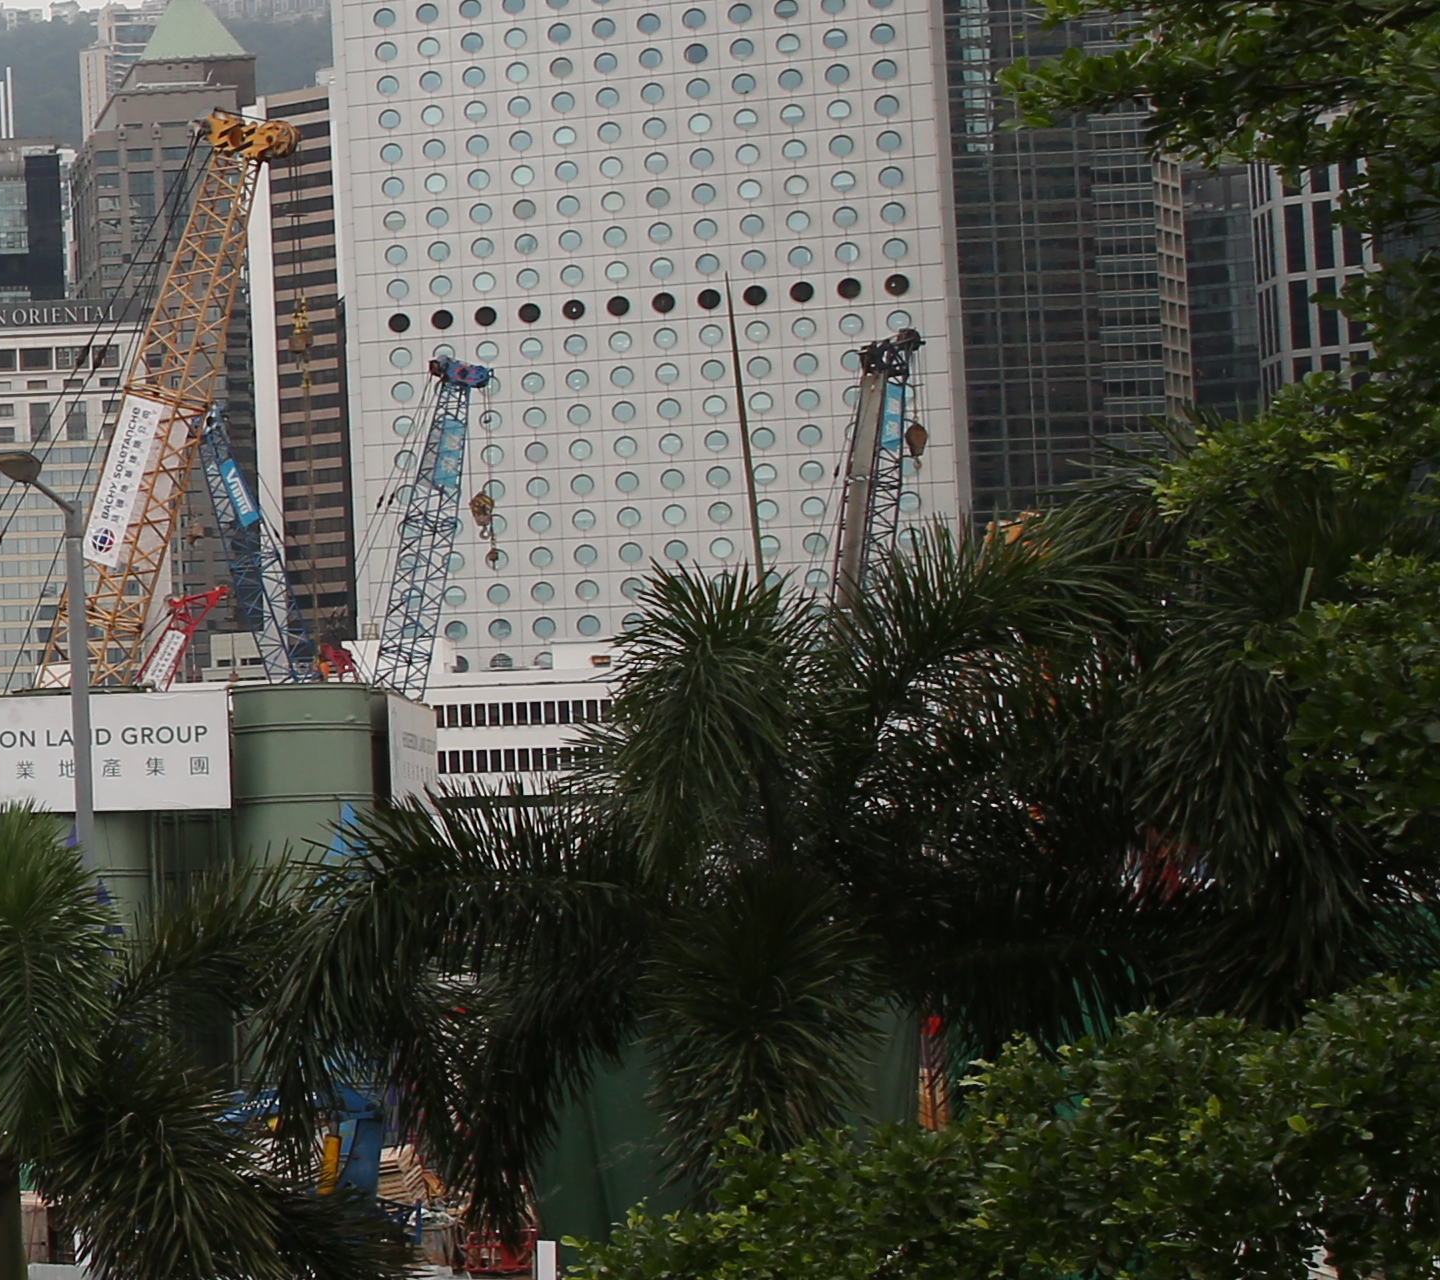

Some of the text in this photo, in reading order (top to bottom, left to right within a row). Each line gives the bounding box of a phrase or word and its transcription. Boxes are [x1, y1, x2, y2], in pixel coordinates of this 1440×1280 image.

[12, 303, 120, 326] ORIENTAL
[100, 482, 118, 520] BACHY
[45, 727, 112, 748] LAD
[120, 724, 208, 745] GROUP
